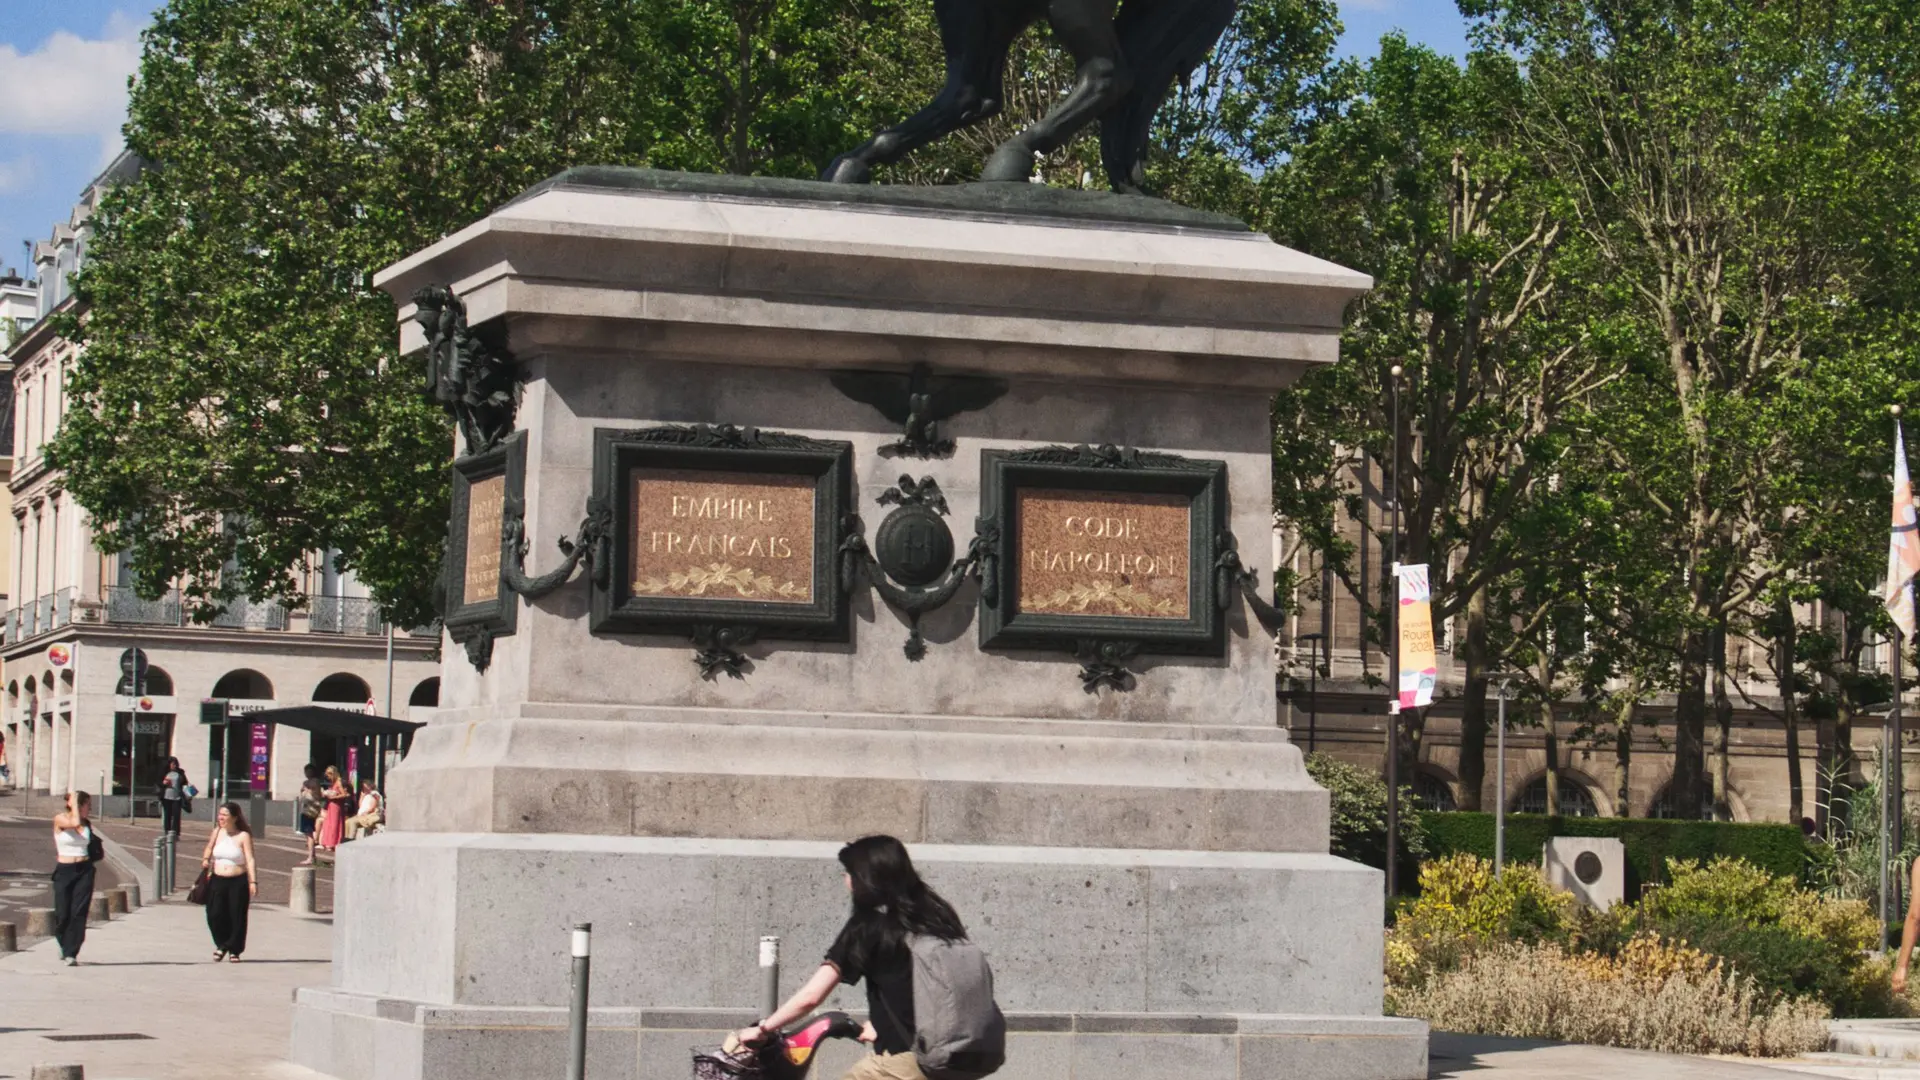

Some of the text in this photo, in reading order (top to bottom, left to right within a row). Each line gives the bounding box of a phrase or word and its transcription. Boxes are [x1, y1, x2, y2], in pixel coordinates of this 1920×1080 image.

[672, 495, 773, 521] EMPIRE
[1065, 515, 1140, 540] CODE
[1030, 550, 1175, 575] NAPOLEON
[228, 704, 265, 712] ERVICES
